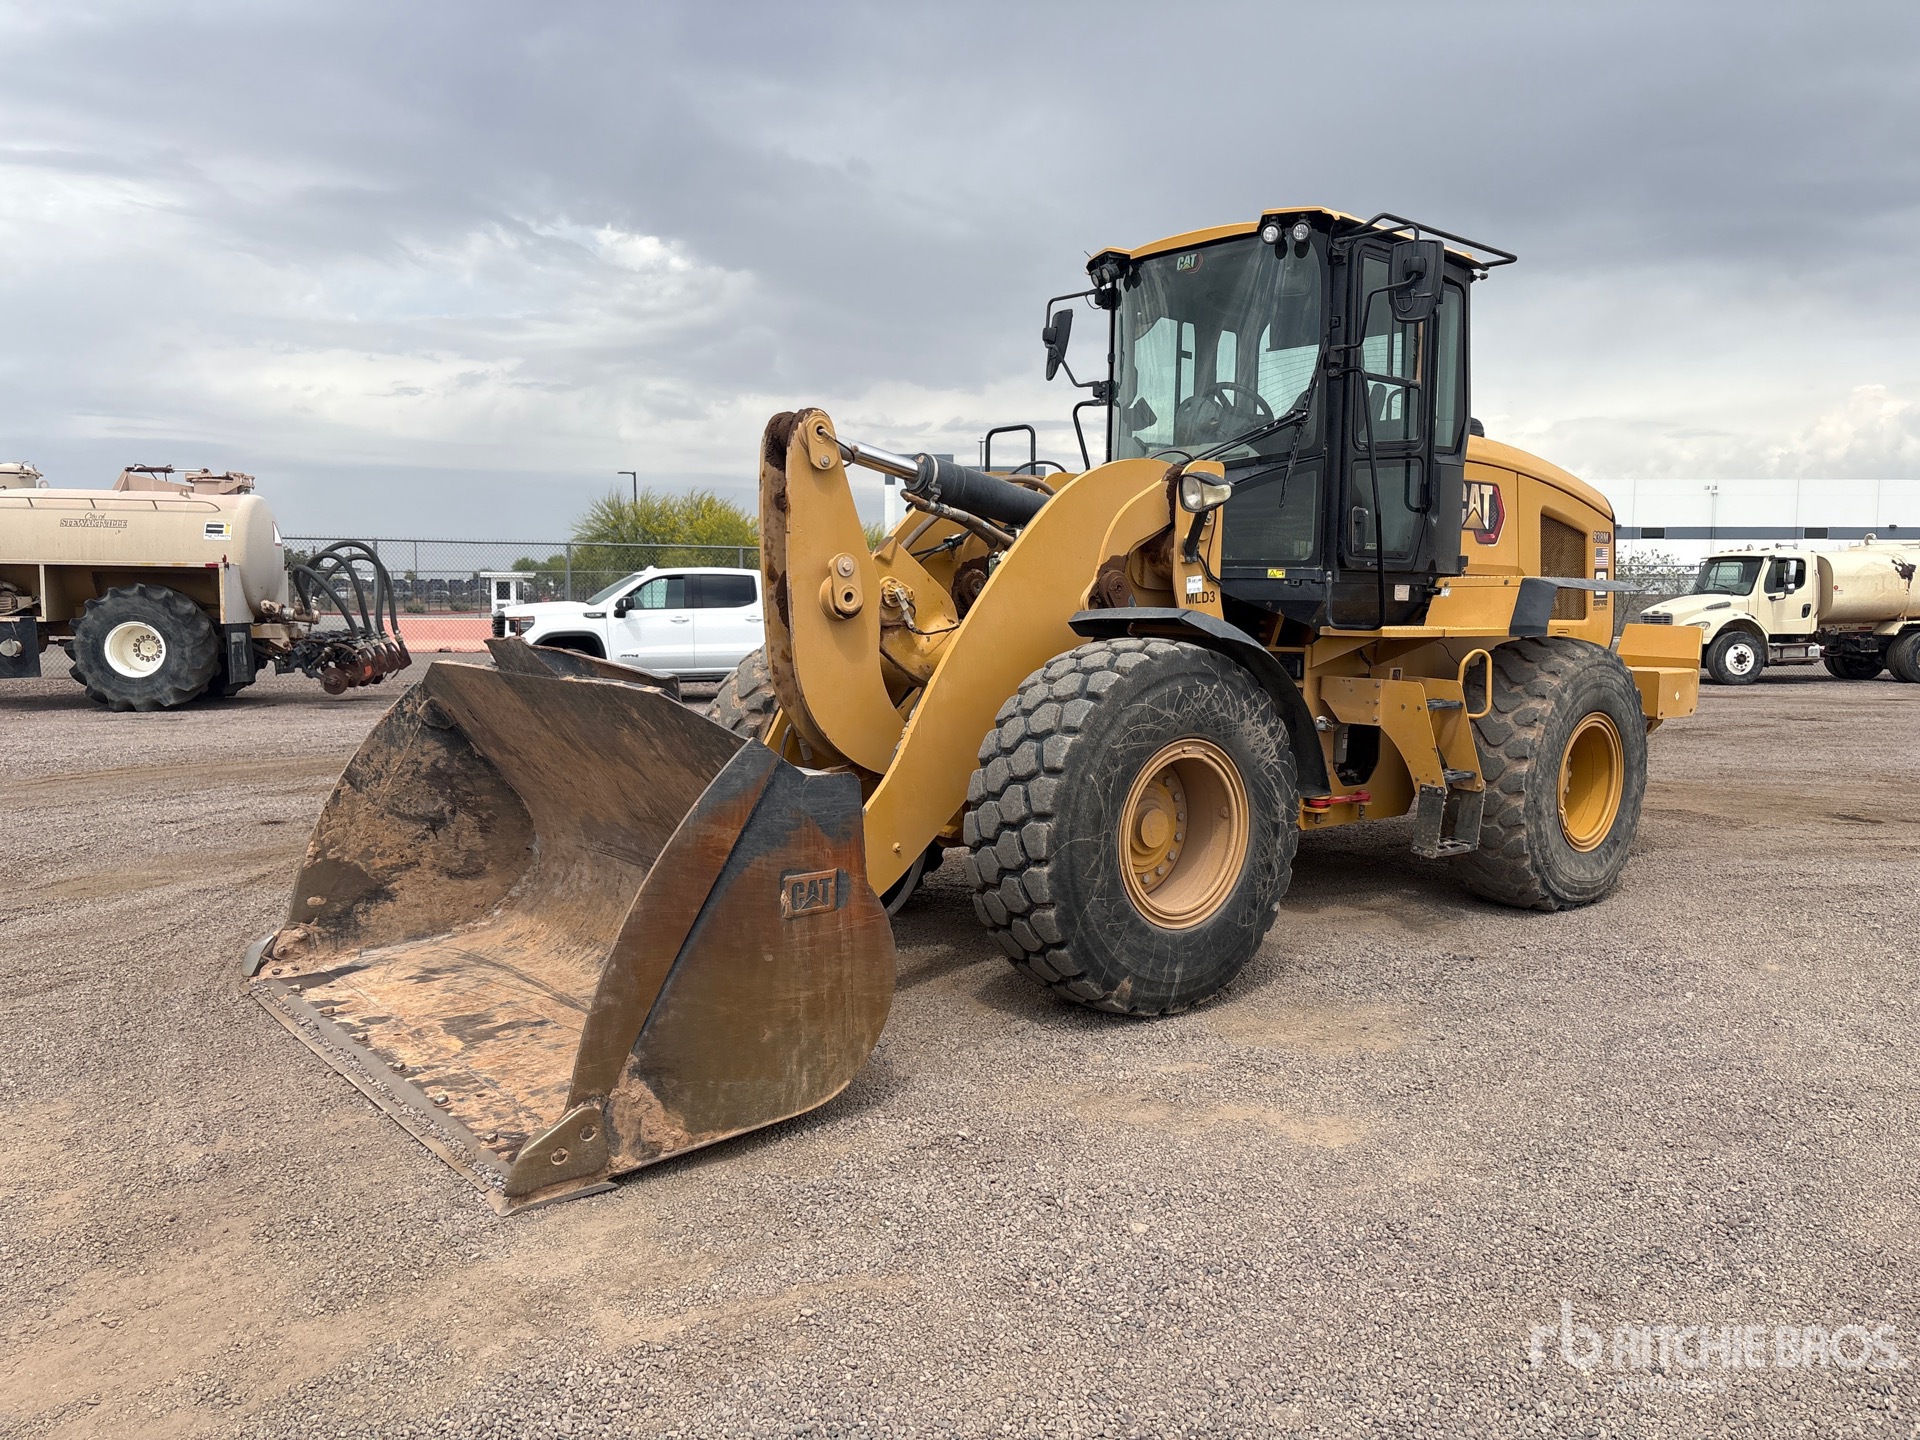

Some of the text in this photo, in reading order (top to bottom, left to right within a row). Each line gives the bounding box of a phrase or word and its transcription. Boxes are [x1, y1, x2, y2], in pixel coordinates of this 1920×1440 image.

[1176, 253, 1198, 271] CAT
[1185, 590, 1216, 605] MLD3
[791, 877, 833, 911] CAT
